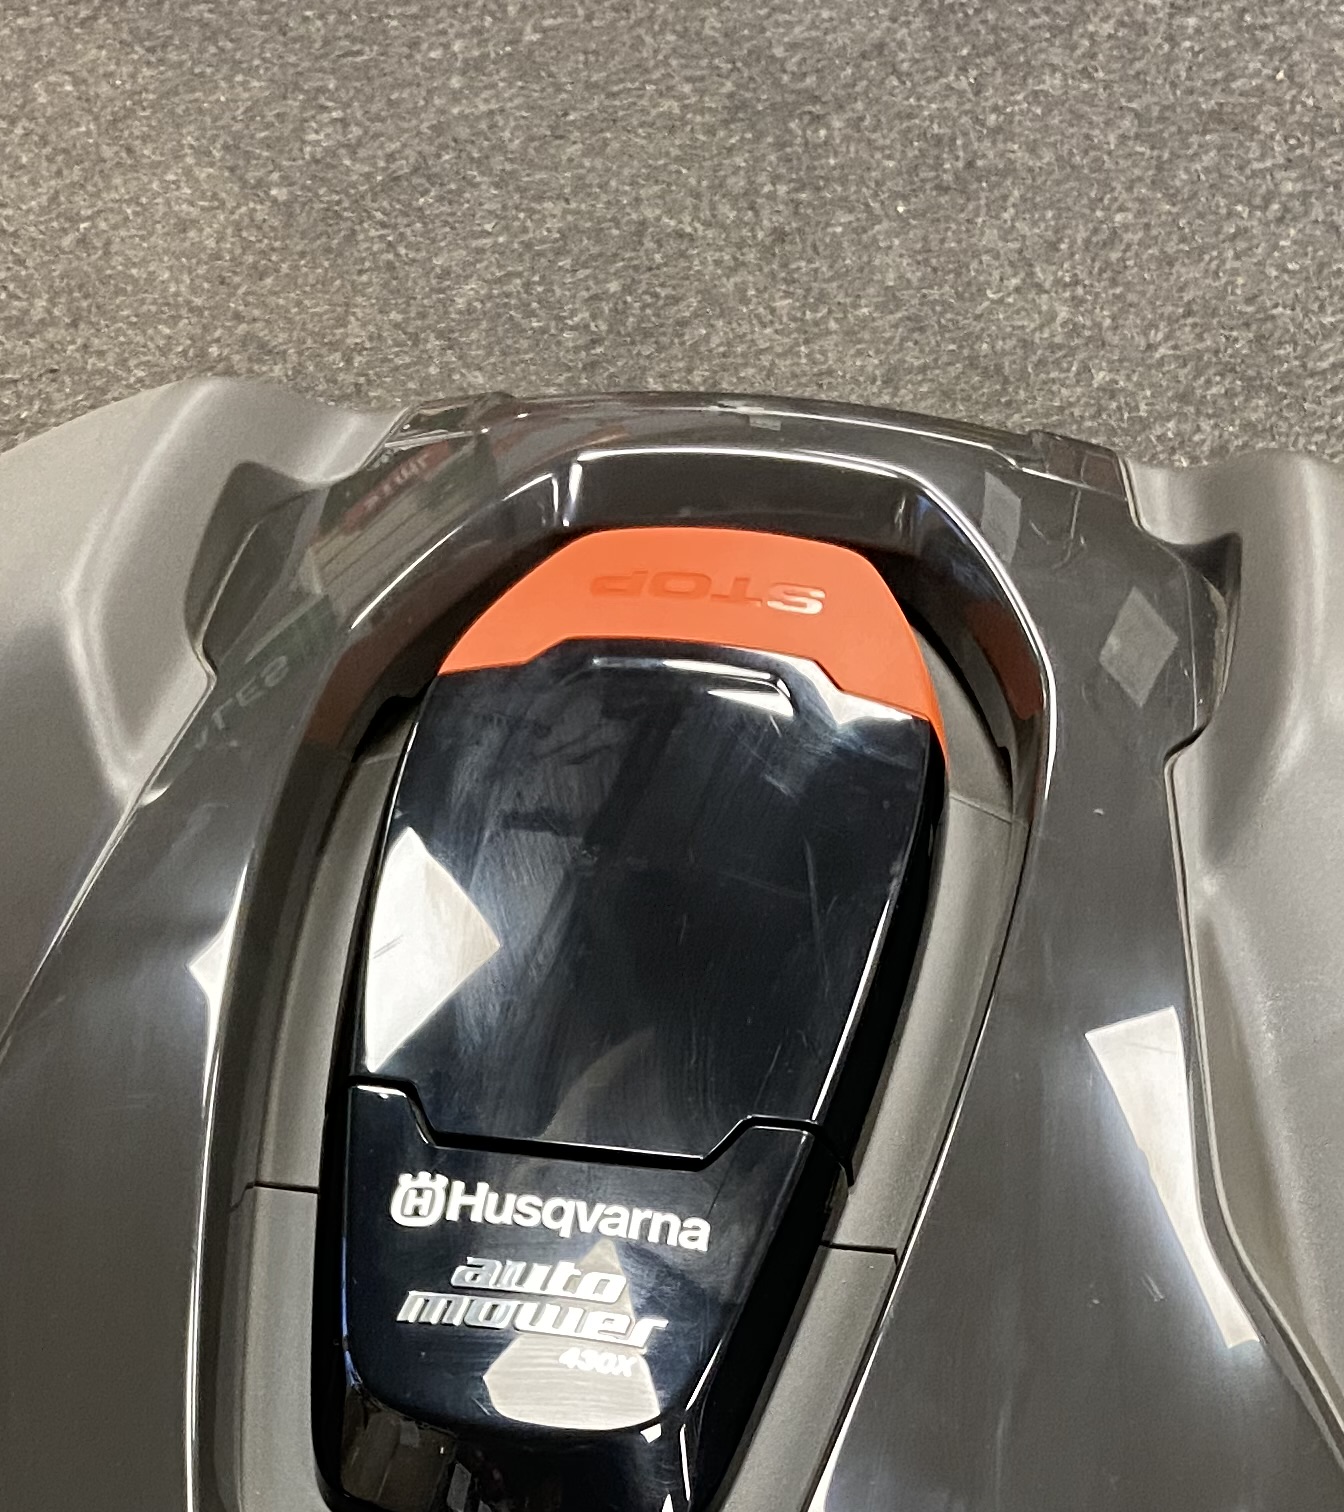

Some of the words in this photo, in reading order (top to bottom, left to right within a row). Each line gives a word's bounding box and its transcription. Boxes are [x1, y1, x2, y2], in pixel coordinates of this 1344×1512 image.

[589, 571, 826, 614] STOP
[446, 1180, 711, 1252] Husqvarna
[450, 1256, 629, 1304] auto
[396, 1290, 669, 1350] mower
[558, 1346, 637, 1378] 430X
